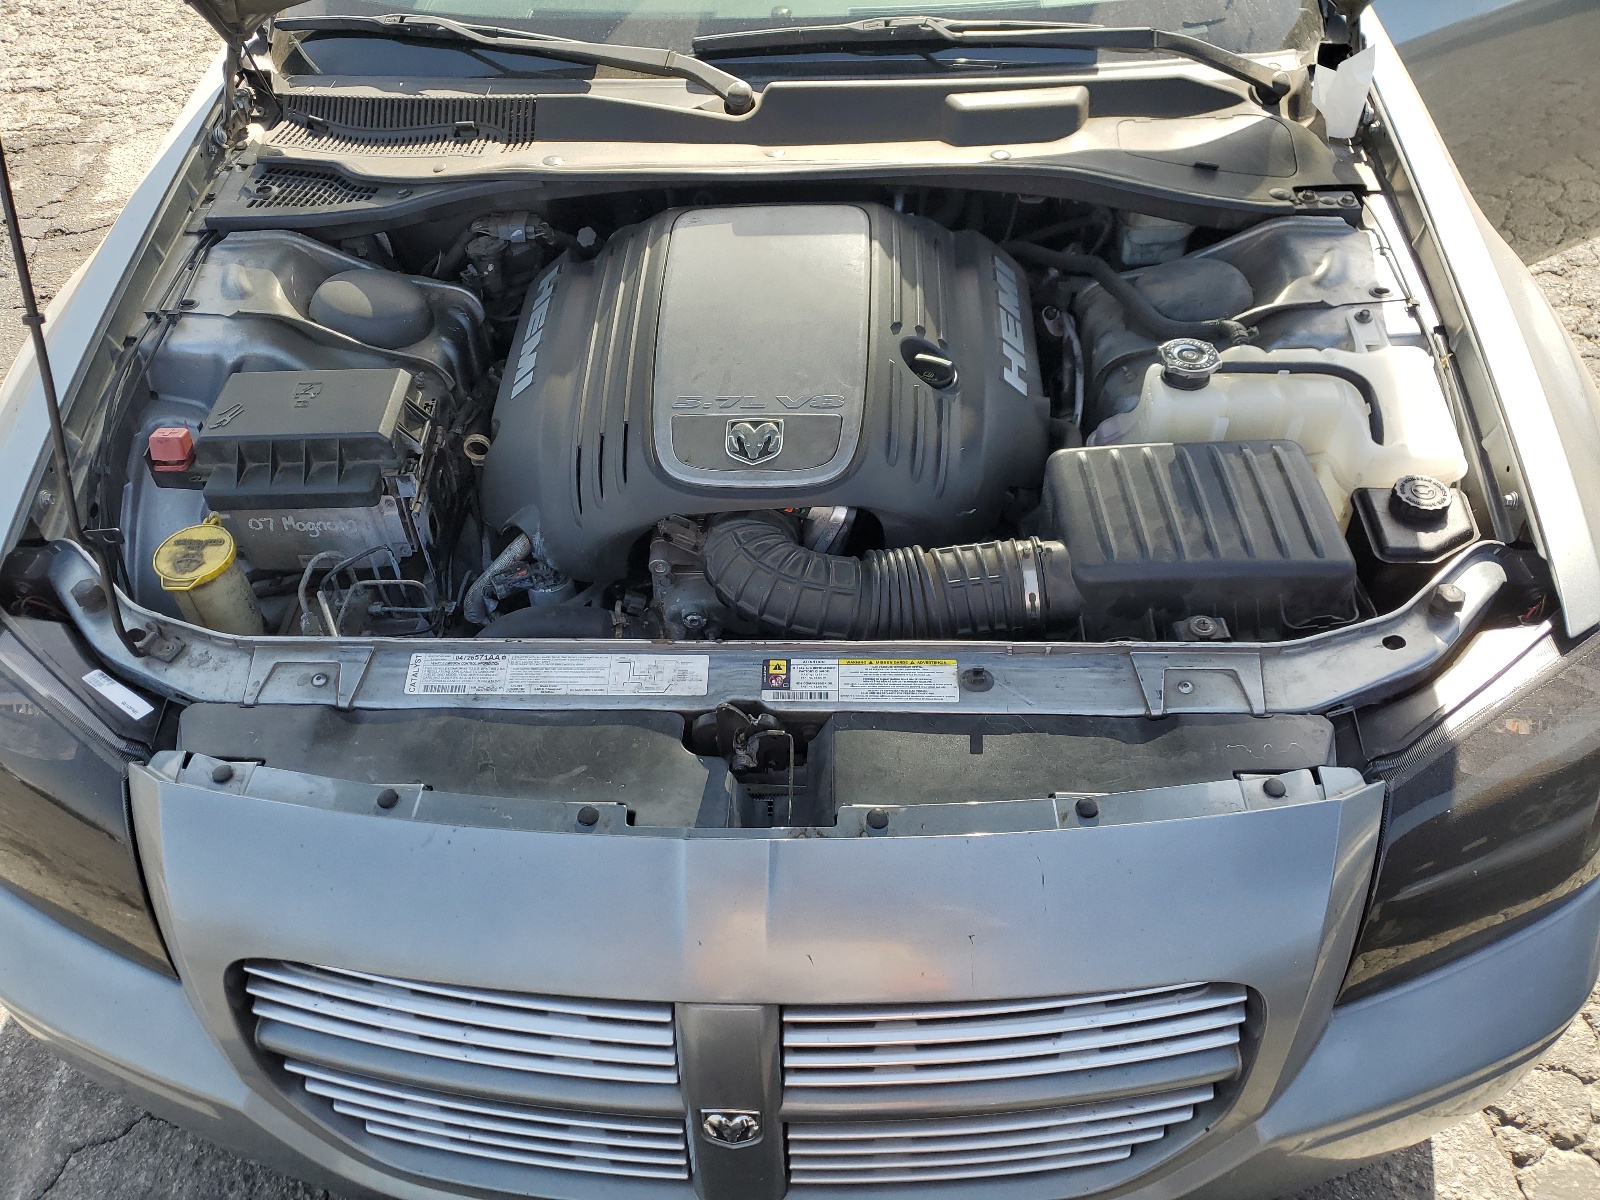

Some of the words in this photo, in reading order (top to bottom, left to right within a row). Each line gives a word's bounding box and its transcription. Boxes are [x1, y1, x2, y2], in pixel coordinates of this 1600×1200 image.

[510, 264, 560, 400] HEMI
[994, 255, 1028, 397] HEMI
[671, 395, 768, 409] 5.7L
[775, 394, 846, 409] V8
[248, 515, 275, 532] 07
[408, 654, 423, 693] CATALYST
